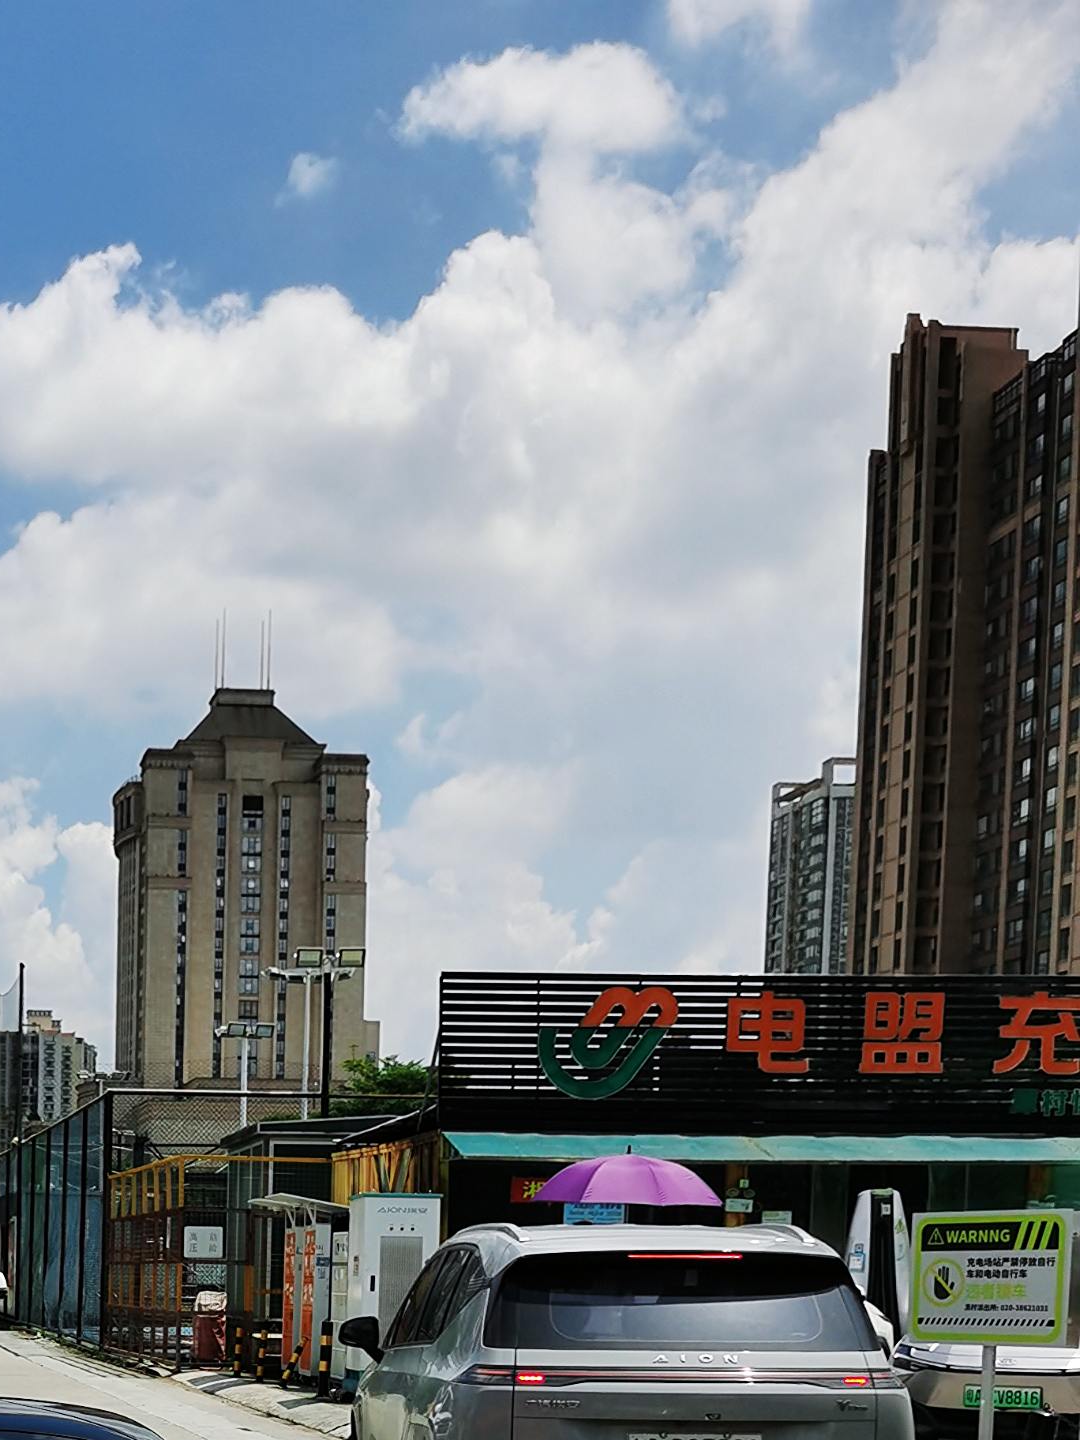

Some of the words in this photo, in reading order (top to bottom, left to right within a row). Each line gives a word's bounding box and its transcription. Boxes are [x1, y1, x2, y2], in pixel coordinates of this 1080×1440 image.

[726, 991, 1080, 1075] 电盟充
[946, 1229, 1012, 1243] WARNNG
[652, 1353, 739, 1365] AION
